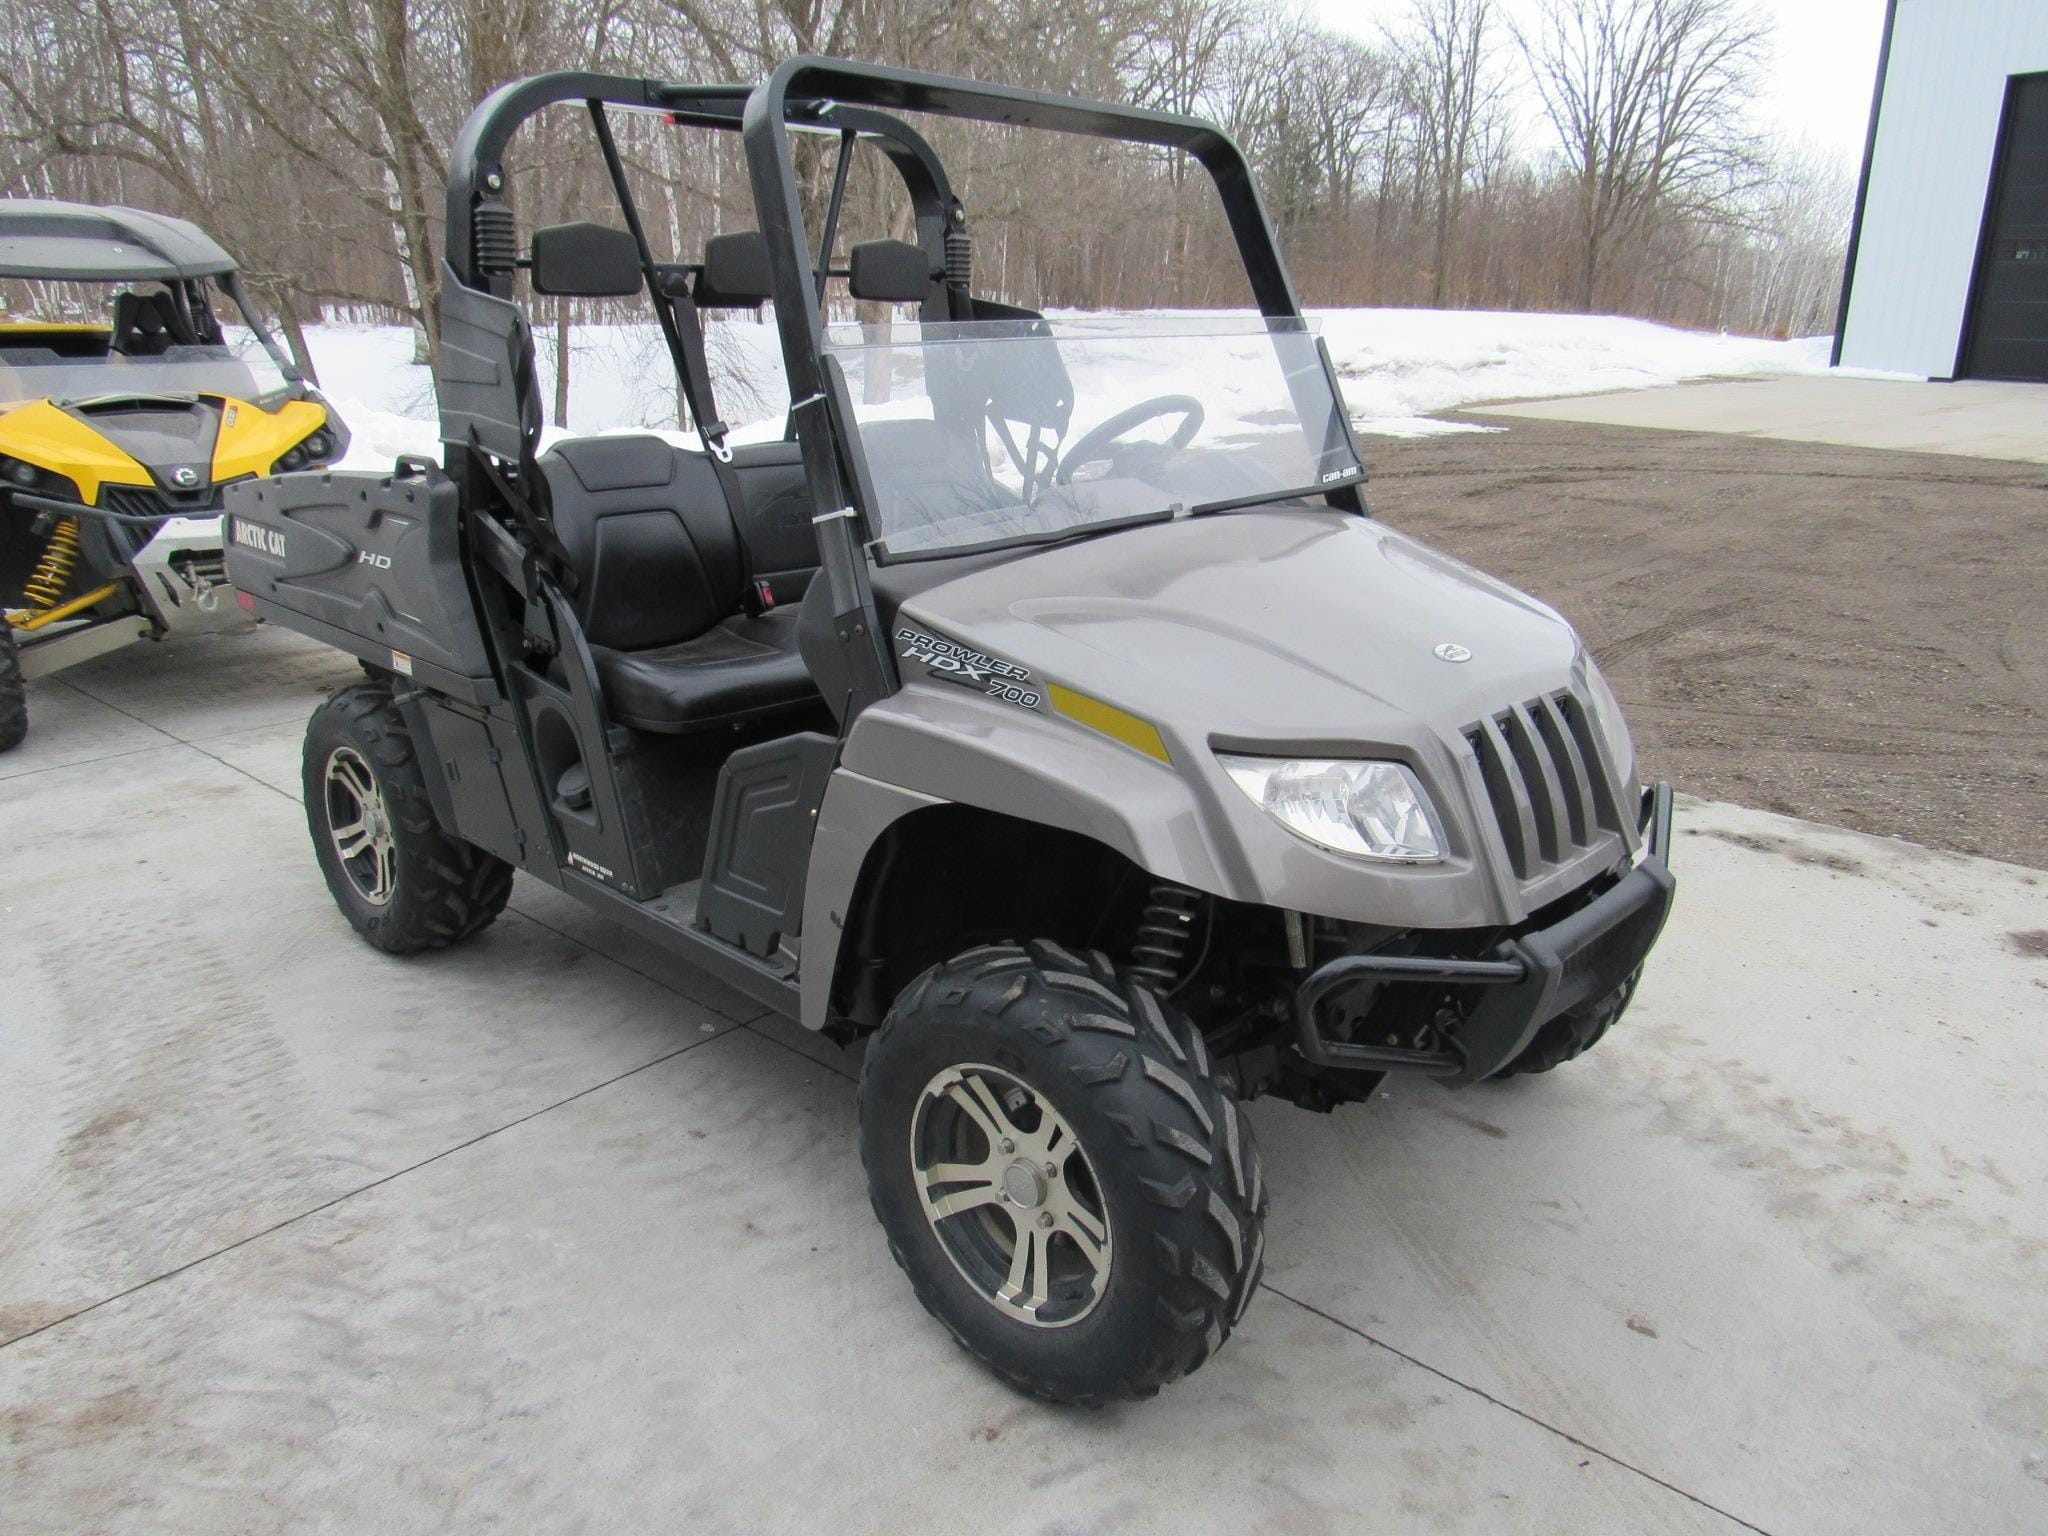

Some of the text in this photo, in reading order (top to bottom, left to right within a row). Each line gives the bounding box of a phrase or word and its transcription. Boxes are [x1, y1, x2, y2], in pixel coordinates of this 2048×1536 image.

[1322, 466, 1357, 483] can-am
[235, 520, 286, 557] ARCTIC CAT
[358, 550, 392, 570] HD
[896, 628, 1030, 681] PROWLER
[901, 646, 1041, 708] HDX 700
